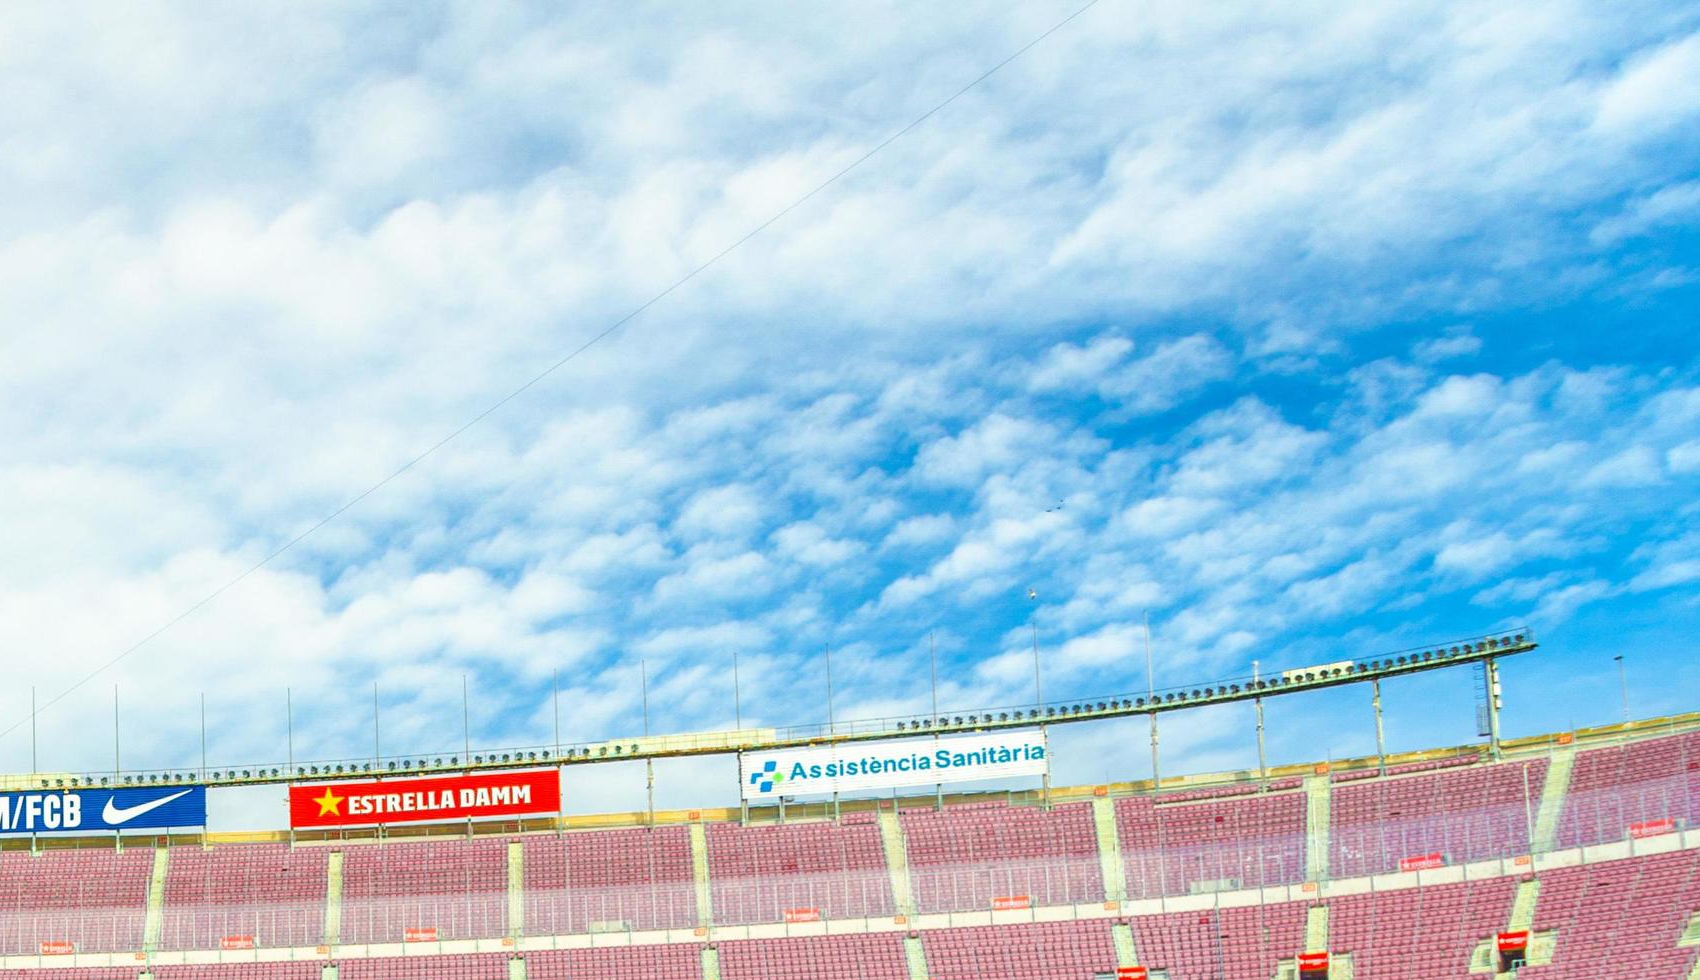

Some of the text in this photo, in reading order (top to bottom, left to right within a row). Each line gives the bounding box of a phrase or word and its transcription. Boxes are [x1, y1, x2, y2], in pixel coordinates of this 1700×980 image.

[790, 743, 1046, 780] Assistència Sanitària
[347, 783, 532, 815] ESTRELLA DAMM
